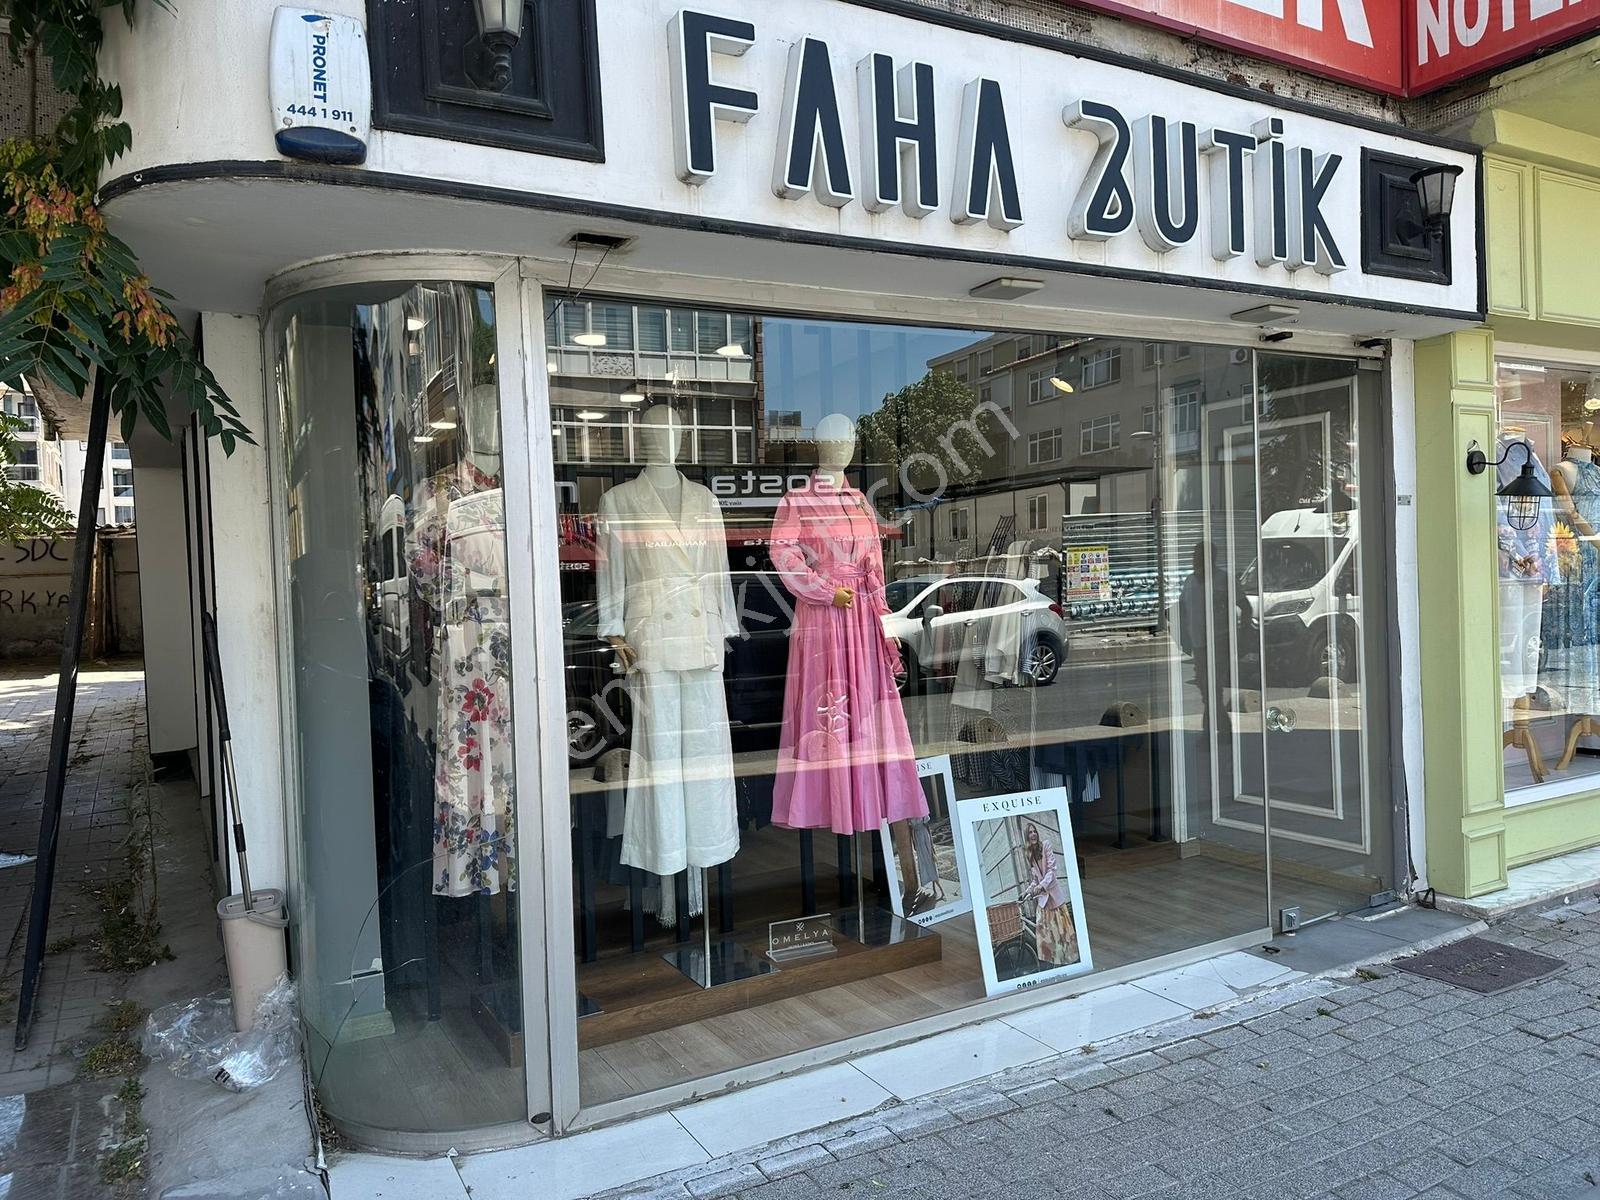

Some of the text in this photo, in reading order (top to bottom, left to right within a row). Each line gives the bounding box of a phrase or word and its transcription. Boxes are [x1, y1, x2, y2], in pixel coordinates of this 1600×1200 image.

[312, 34, 327, 103] PRONET
[287, 104, 353, 122] 444 1 911
[674, 9, 1347, 271] FAHA BUTİK
[983, 796, 1041, 812] EXQUISE
[772, 929, 829, 945] OMELYA
